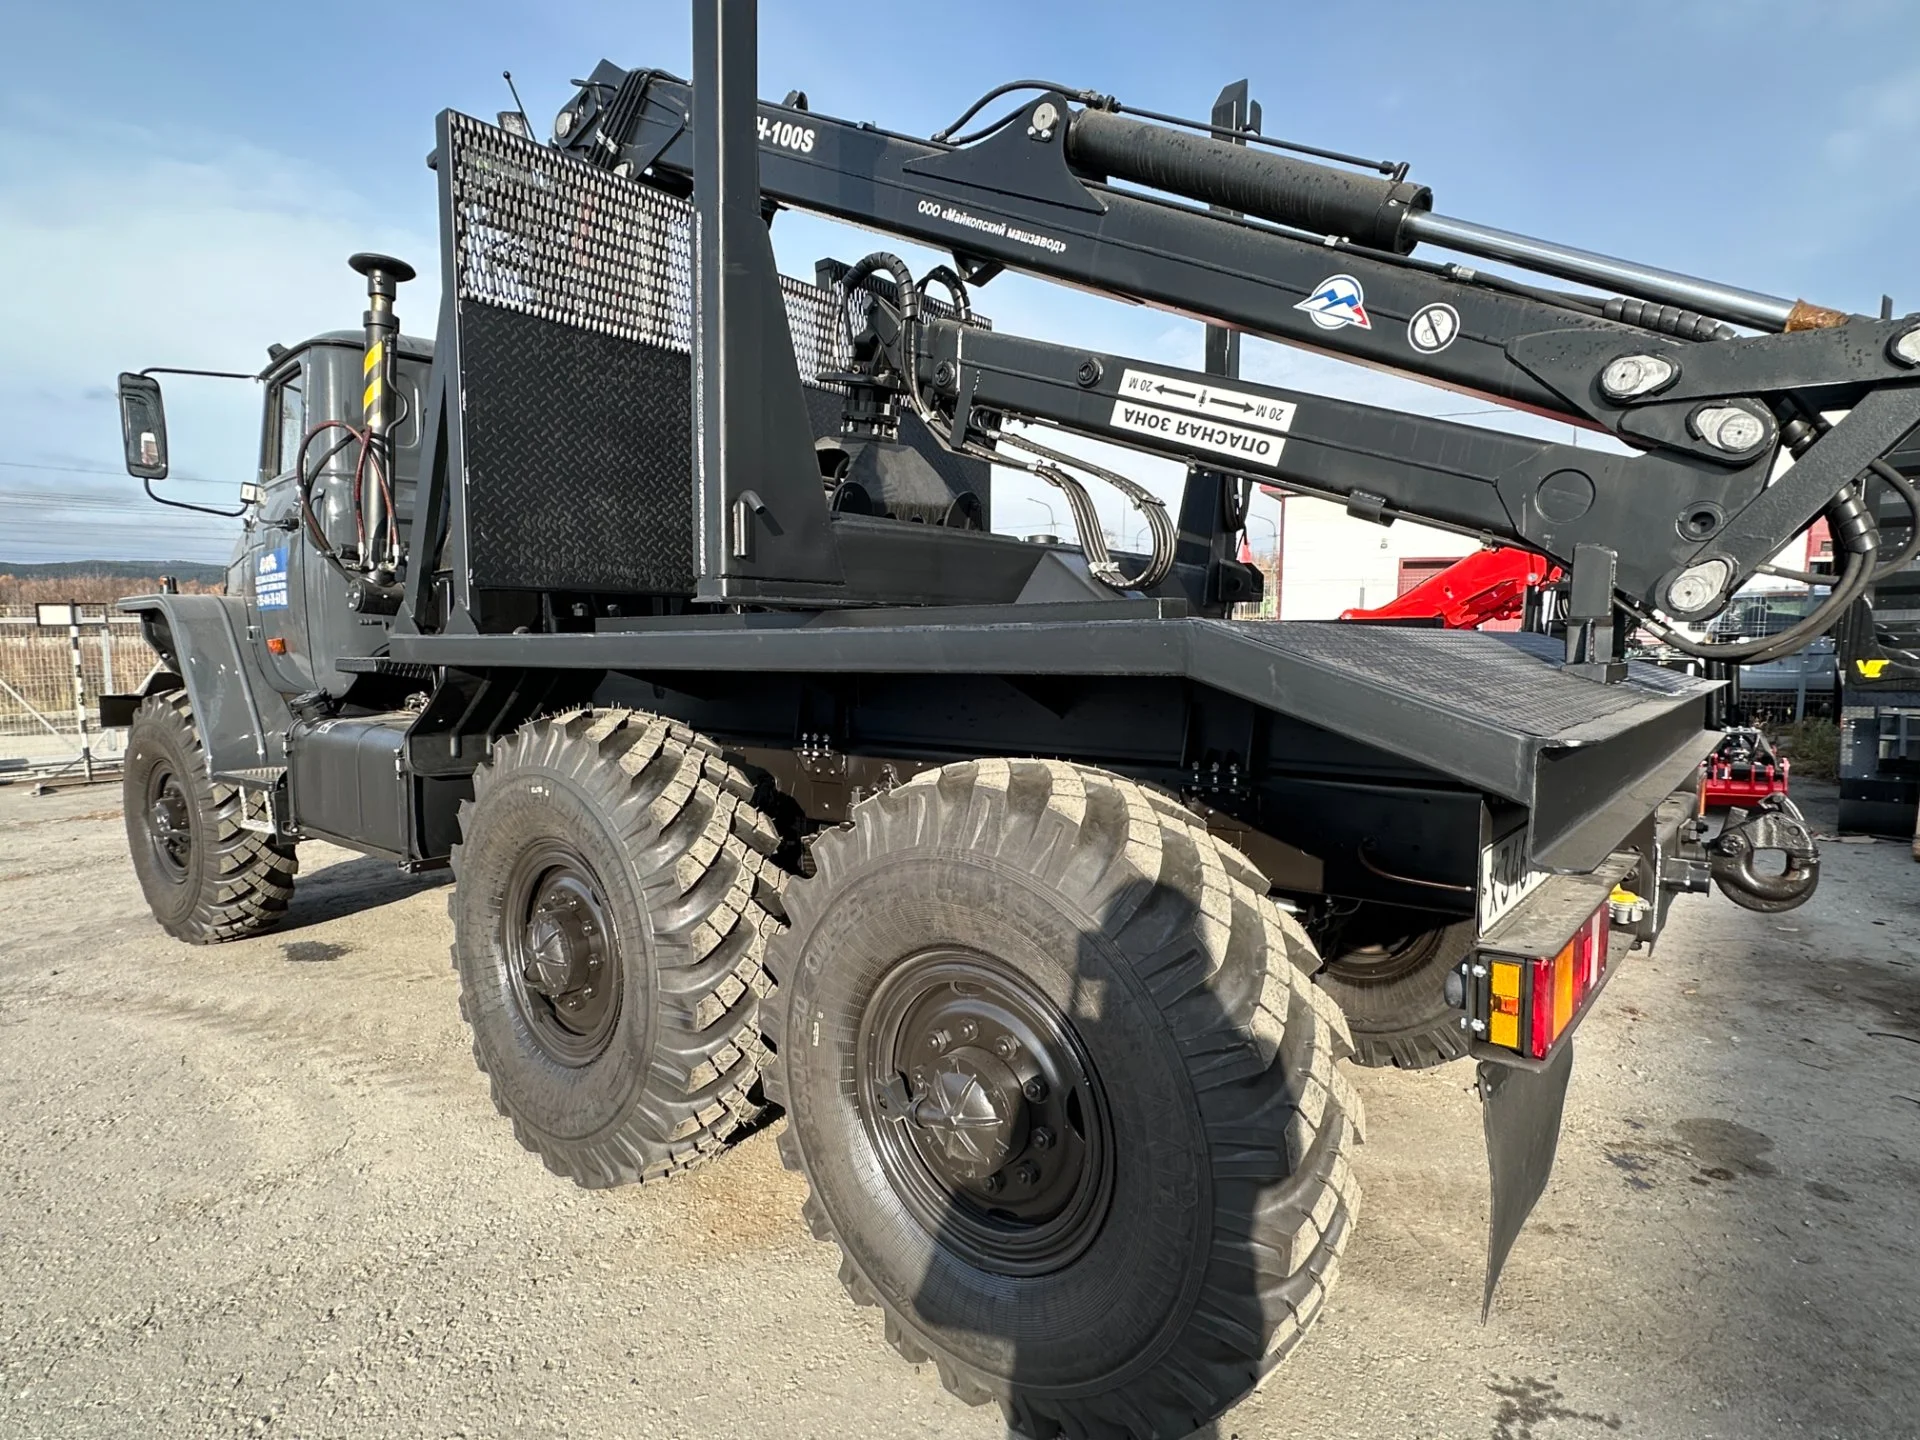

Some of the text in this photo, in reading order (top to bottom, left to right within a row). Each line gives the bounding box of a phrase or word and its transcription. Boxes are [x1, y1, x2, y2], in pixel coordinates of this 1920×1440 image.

[918, 200, 1067, 253] ООО «Майкопский машзавод»
[1140, 378, 1154, 392] 20
[1269, 408, 1285, 421] 20
[1124, 408, 1271, 456] ОПАСНАЯ ЗОНА
